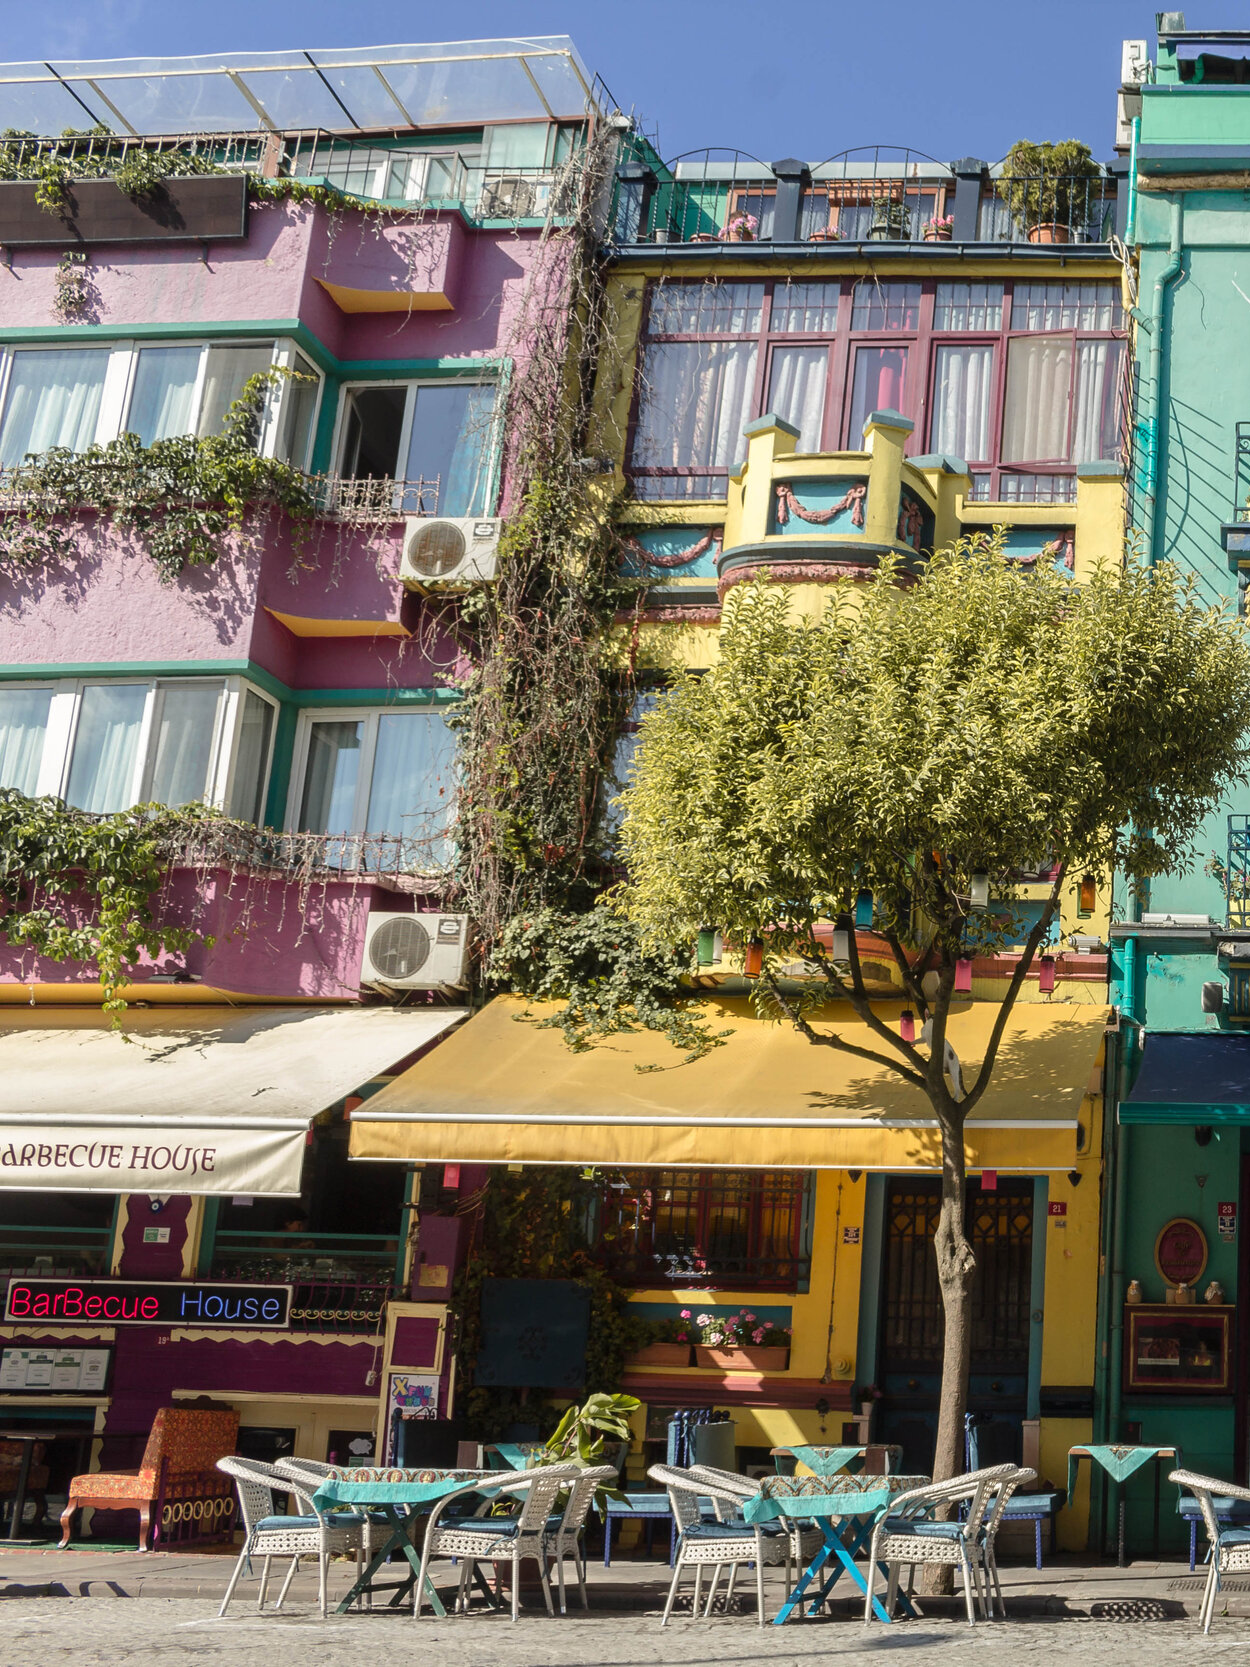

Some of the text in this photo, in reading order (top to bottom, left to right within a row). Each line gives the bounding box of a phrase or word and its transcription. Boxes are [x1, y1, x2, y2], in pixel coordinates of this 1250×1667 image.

[0, 1141, 216, 1175] ARBECUE HOUSE
[1052, 1204, 1061, 1213] 21
[1222, 1205, 1233, 1214] 23
[10, 1287, 280, 1320] BarBecue House
